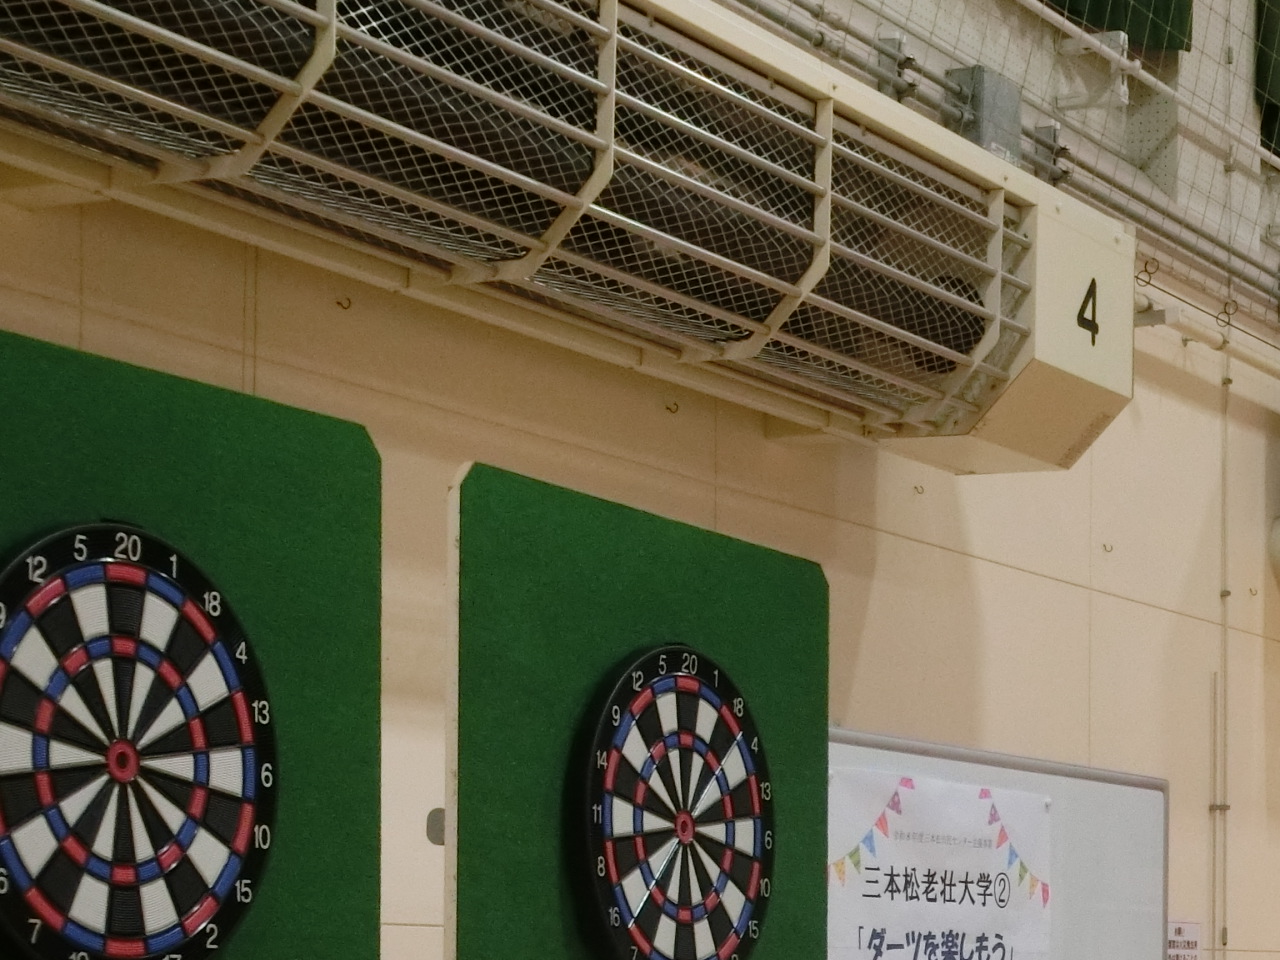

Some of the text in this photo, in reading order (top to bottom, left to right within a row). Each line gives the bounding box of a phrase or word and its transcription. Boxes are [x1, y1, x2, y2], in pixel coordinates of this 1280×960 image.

[1077, 278, 1098, 347] 4
[74, 535, 86, 561] 5
[114, 534, 141, 561] 20
[26, 556, 47, 583] 12
[169, 555, 178, 578] 1
[204, 592, 220, 616] 18
[236, 642, 247, 664] 4
[681, 654, 698, 674] 20
[658, 654, 667, 675] 5
[631, 670, 644, 692] 12
[713, 669, 719, 687] 1
[252, 700, 269, 724] 13
[611, 705, 621, 727] 9
[733, 697, 744, 717] 18
[751, 736, 759, 753] 4
[596, 750, 608, 770] 14
[261, 763, 272, 787] 6
[760, 783, 770, 800] 13
[592, 803, 602, 824] 11
[254, 825, 270, 849] 10
[764, 830, 773, 850] 6
[597, 855, 606, 877] 8
[235, 880, 252, 903] 15
[760, 878, 770, 897] 10
[862, 865, 1011, 908] 三本松老壮大学②
[608, 906, 620, 927] 16
[29, 920, 42, 943] 7
[205, 924, 218, 949] 2
[749, 921, 758, 938] 15
